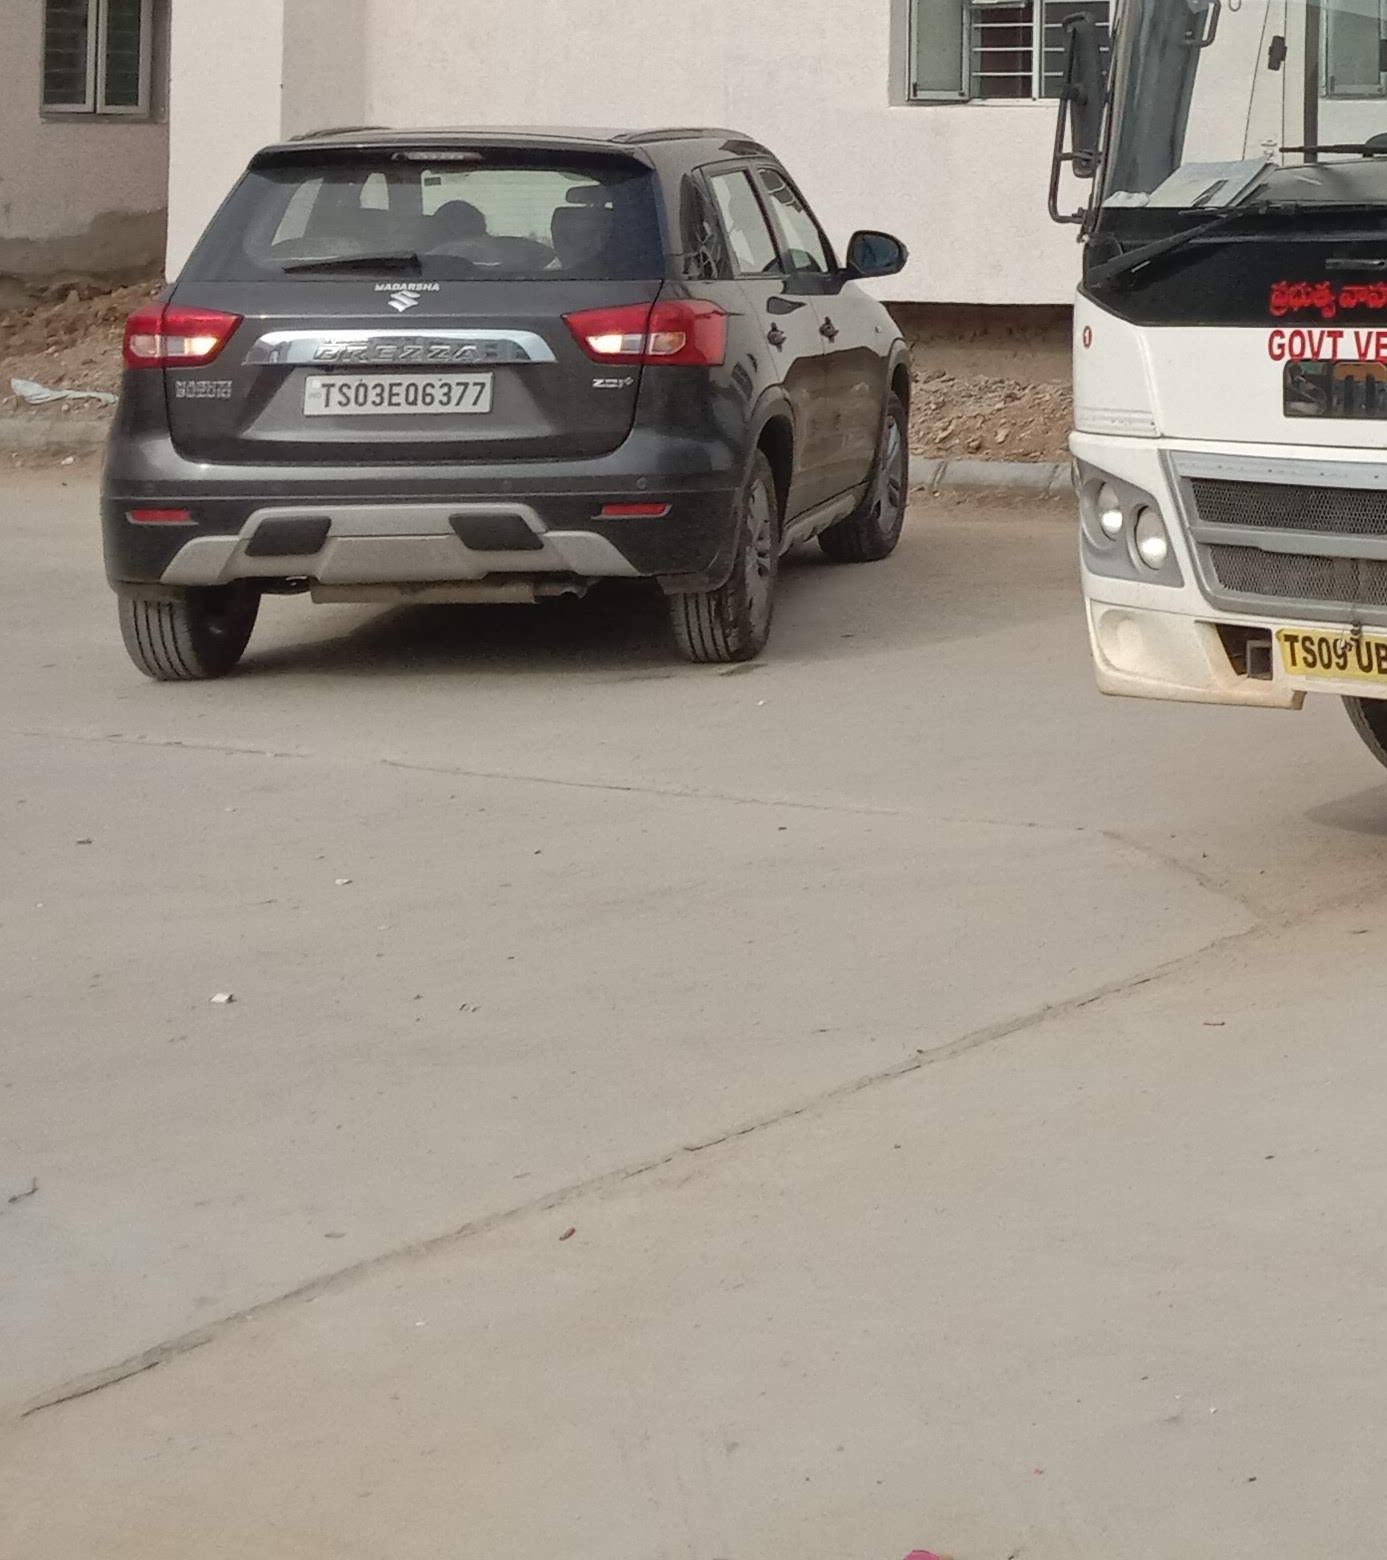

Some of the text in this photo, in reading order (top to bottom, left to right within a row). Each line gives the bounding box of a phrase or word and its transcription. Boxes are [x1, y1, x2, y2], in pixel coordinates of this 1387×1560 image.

[1268, 330, 1344, 361] GOVT
[321, 380, 487, 409] TS03EQ6377
[1284, 634, 1348, 670] TS09
